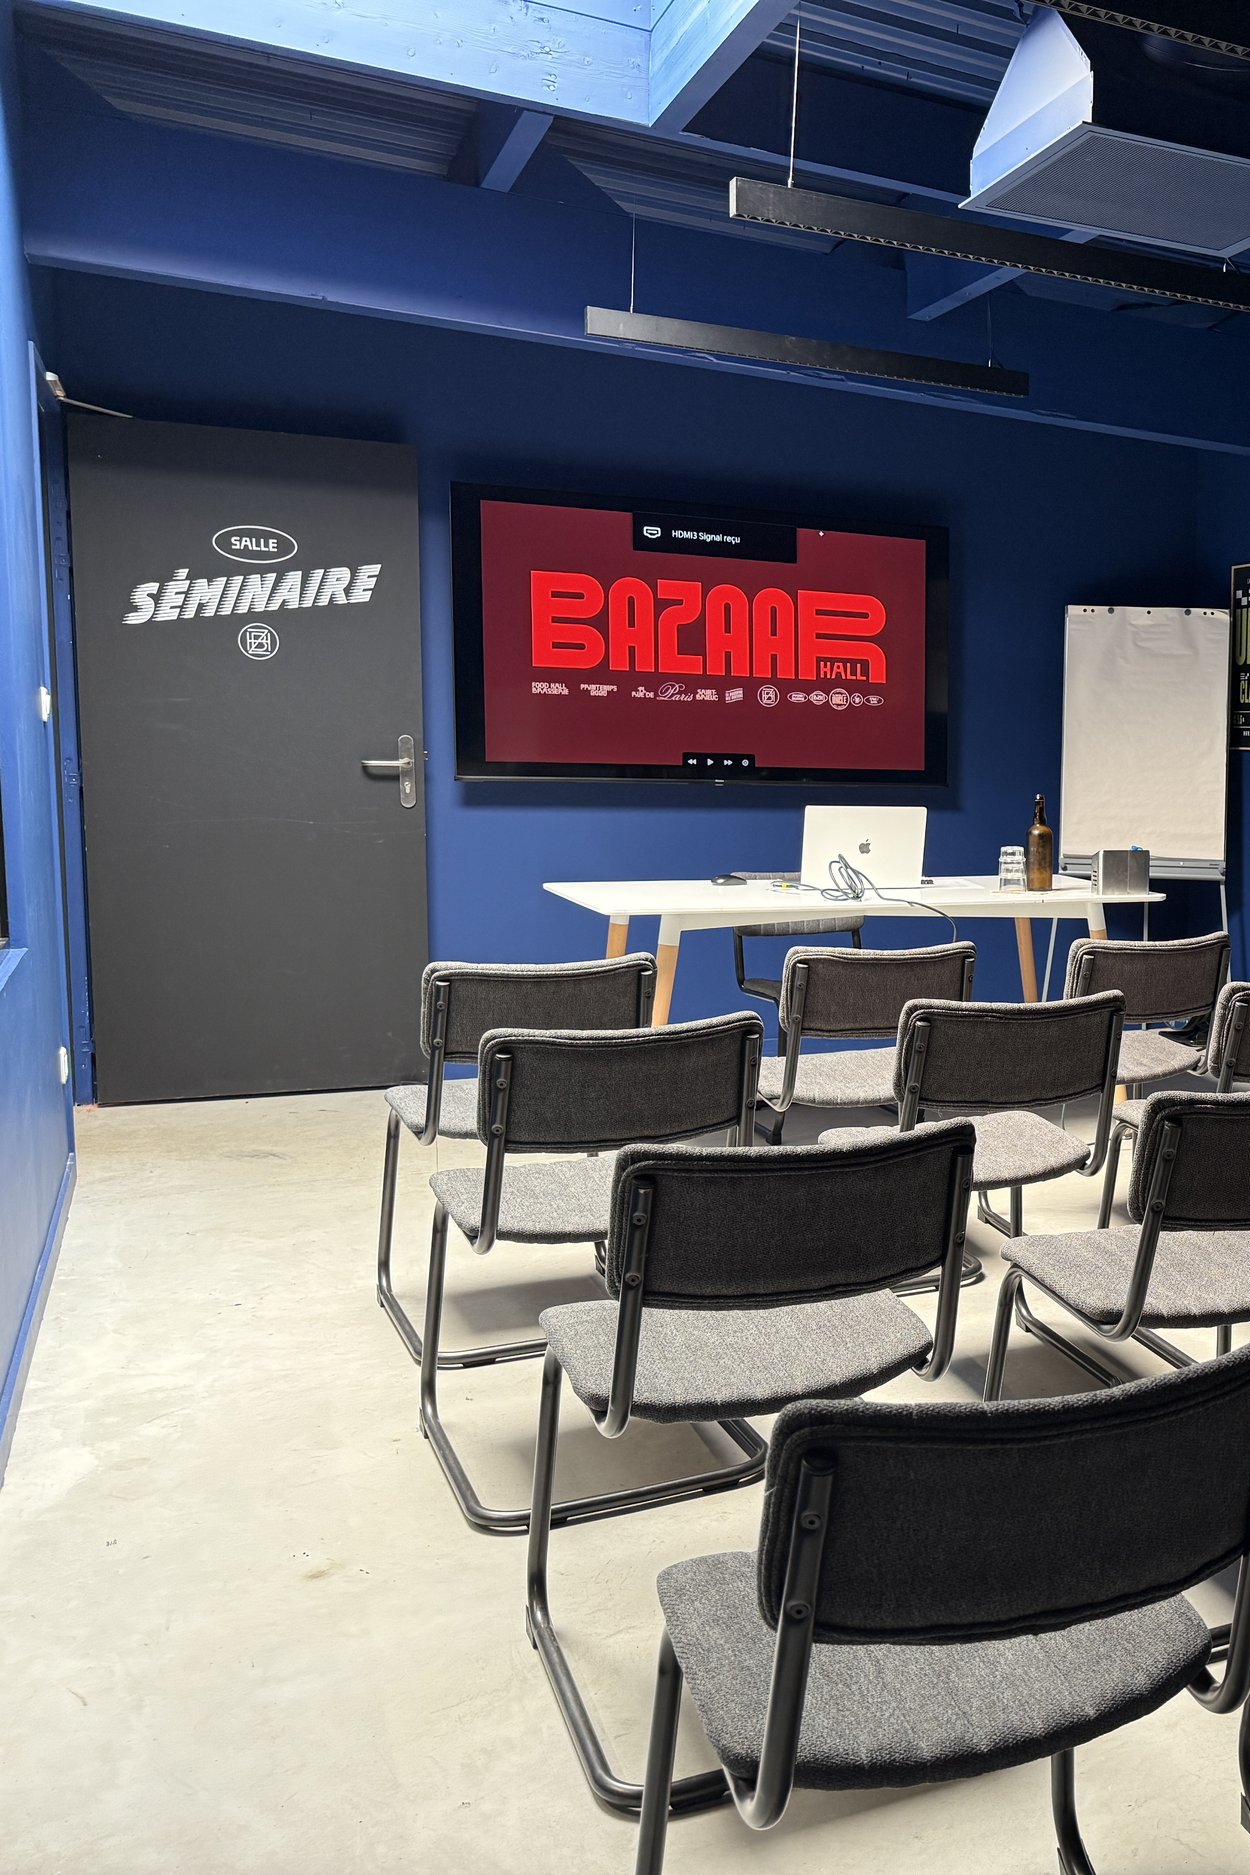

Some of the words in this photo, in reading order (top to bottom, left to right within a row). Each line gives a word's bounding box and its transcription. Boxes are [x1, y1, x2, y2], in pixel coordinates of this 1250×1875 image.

[230, 536, 278, 552] SALLE
[671, 529, 698, 540] HDMI3
[698, 531, 723, 543] Signal
[723, 535, 741, 545] reçu
[121, 563, 382, 624] SÉMINAIRE
[530, 569, 887, 683] BAZAAR
[819, 661, 868, 681] HALL
[656, 682, 694, 702] Paris
